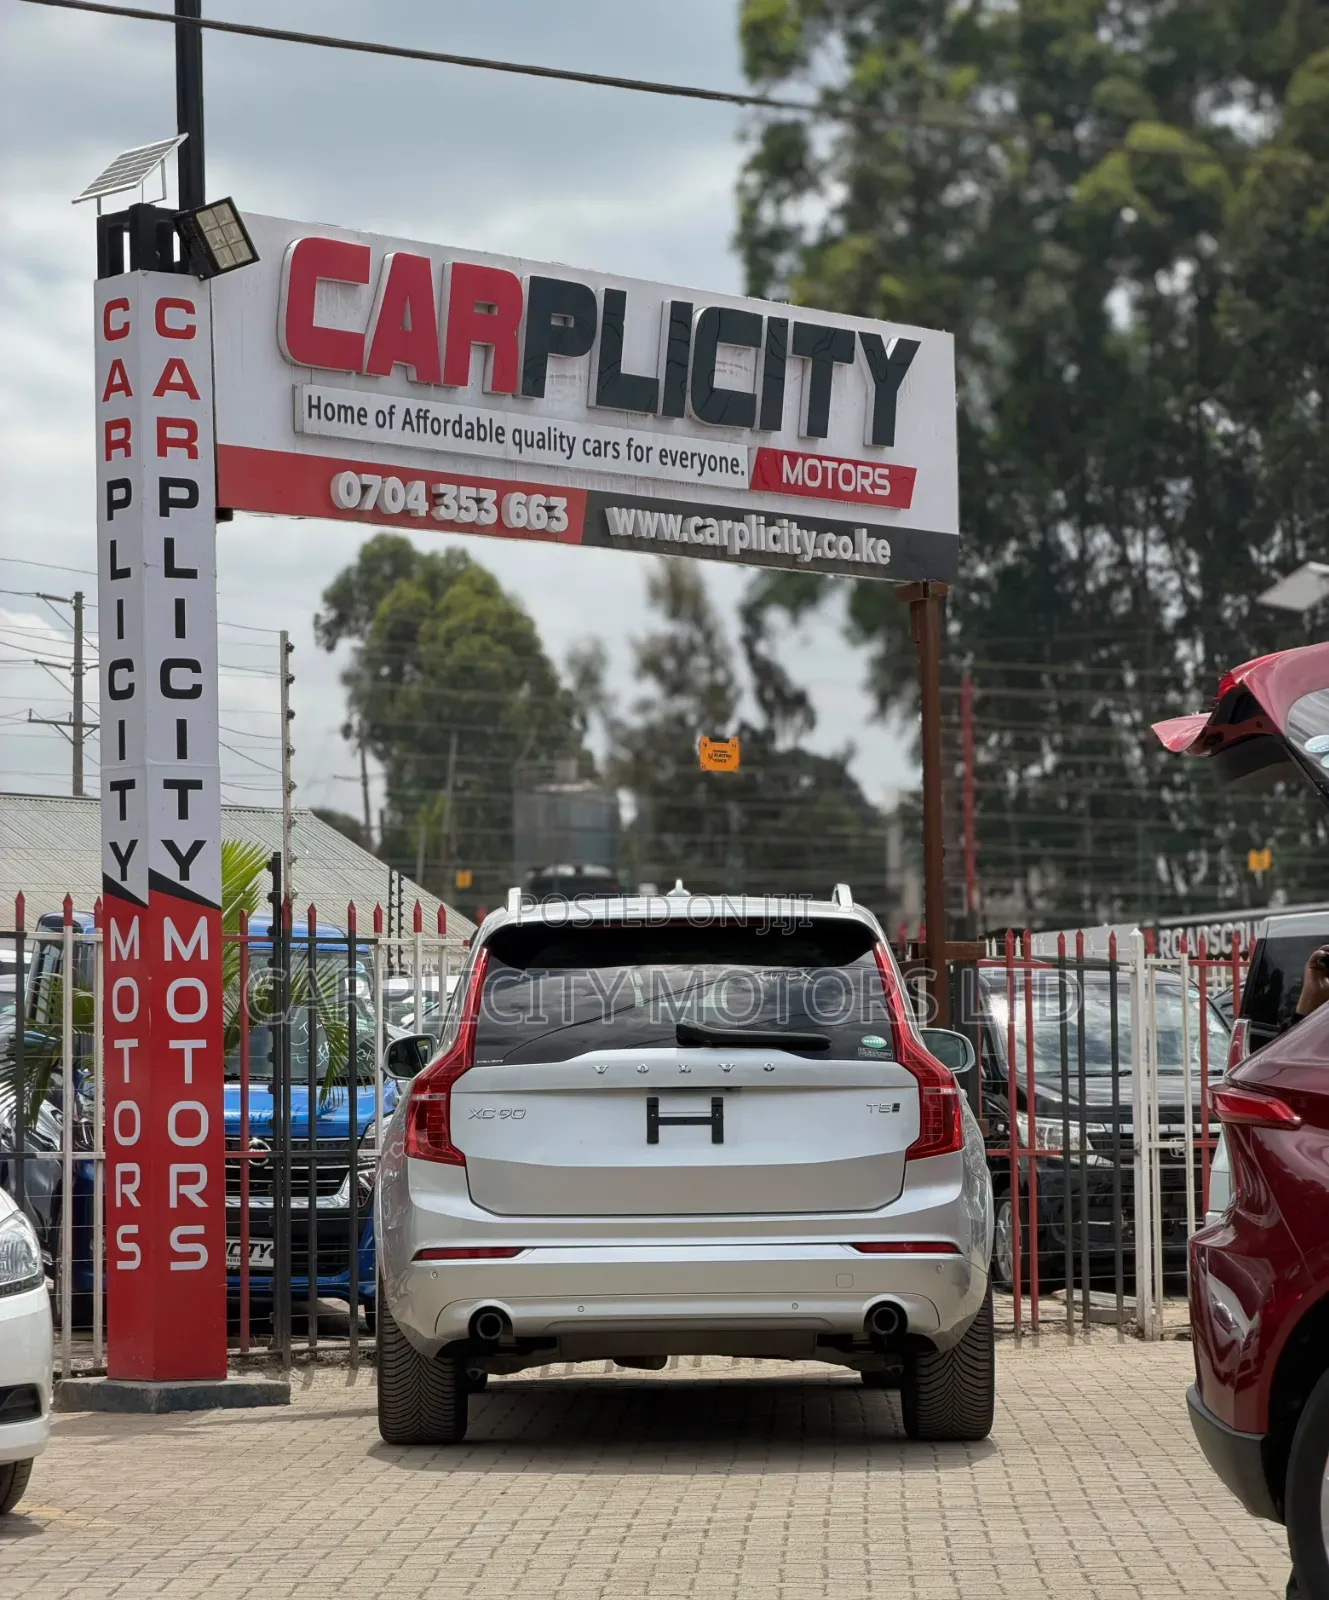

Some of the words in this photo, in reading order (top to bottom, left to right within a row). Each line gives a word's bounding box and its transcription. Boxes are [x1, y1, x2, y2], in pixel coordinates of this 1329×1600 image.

[281, 236, 921, 448] CARPLICITY
[307, 394, 368, 426] Home
[375, 404, 396, 430] of
[401, 407, 506, 444] Affordable
[512, 426, 577, 460] quality
[582, 437, 621, 460] cars
[626, 437, 654, 464] for
[659, 448, 746, 477] everyone.
[331, 470, 429, 517] 0704
[431, 483, 498, 526] 353
[502, 492, 569, 532] 663
[782, 454, 891, 496] MOTORS
[102, 297, 139, 882] CARPLICITY
[152, 296, 208, 881] CARPLICITY
[605, 506, 892, 565] www.carplicity.co.ke
[109, 915, 142, 1271] MOTORS
[163, 916, 209, 1271] MOTORS
[592, 1062, 775, 1075] VOLVO
